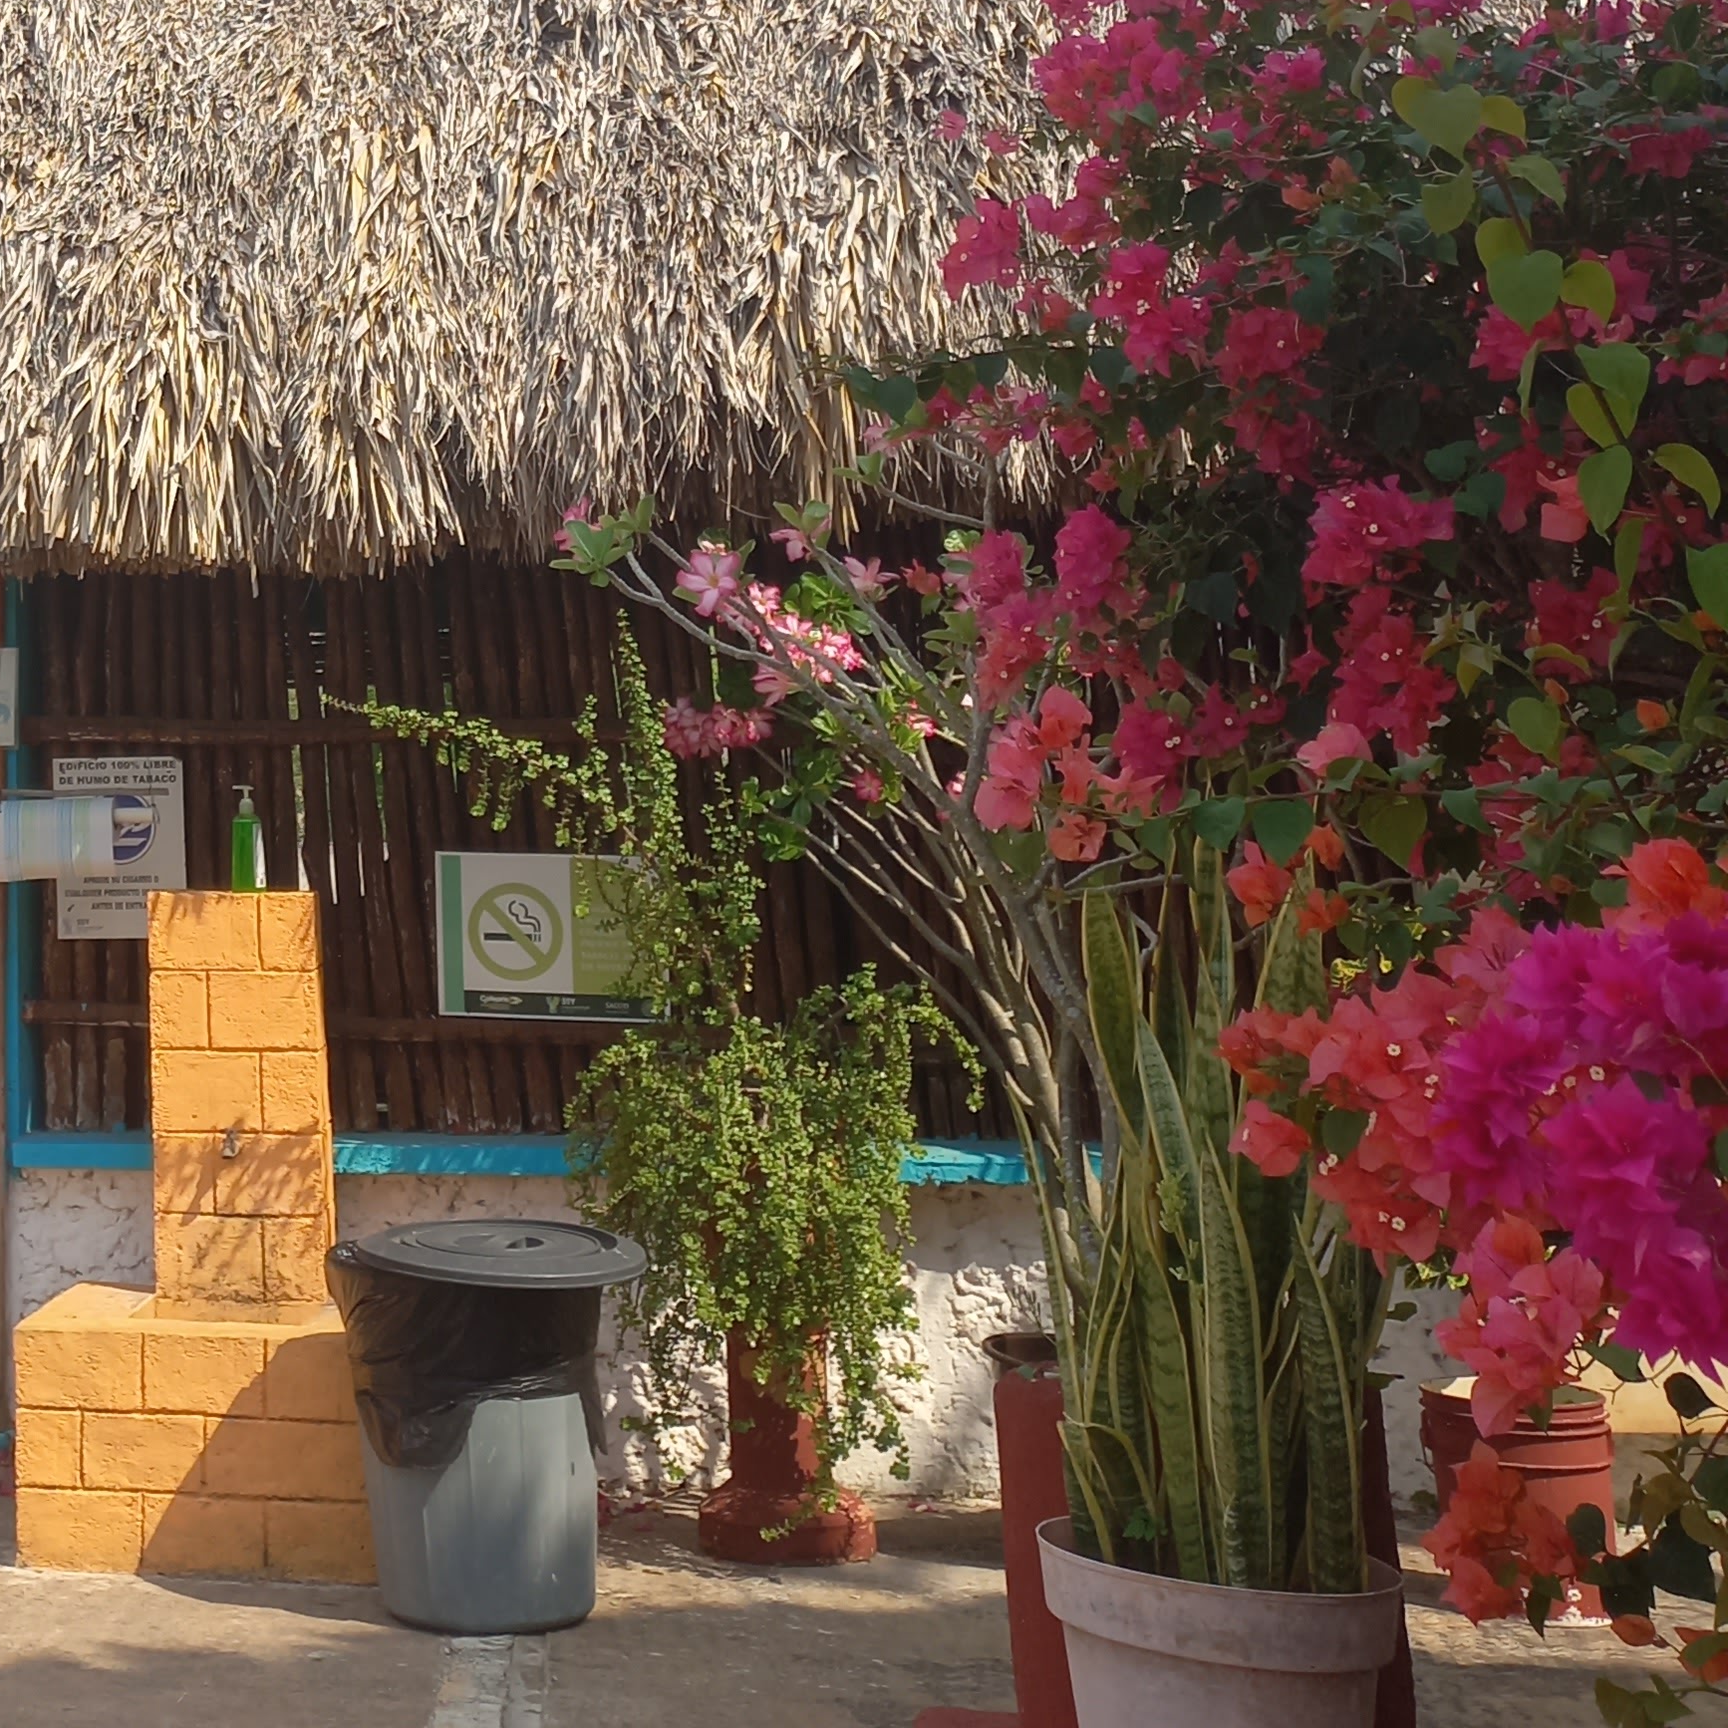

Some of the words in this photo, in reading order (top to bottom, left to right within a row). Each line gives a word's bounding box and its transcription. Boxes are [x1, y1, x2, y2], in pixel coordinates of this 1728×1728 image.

[59, 761, 107, 771] EDIFICIO
[111, 760, 139, 770] 100%
[143, 760, 176, 769] LIBRE
[59, 776, 74, 785] DE
[77, 775, 111, 785] HUMO
[113, 775, 128, 784] DE
[133, 774, 176, 784] TABACO
